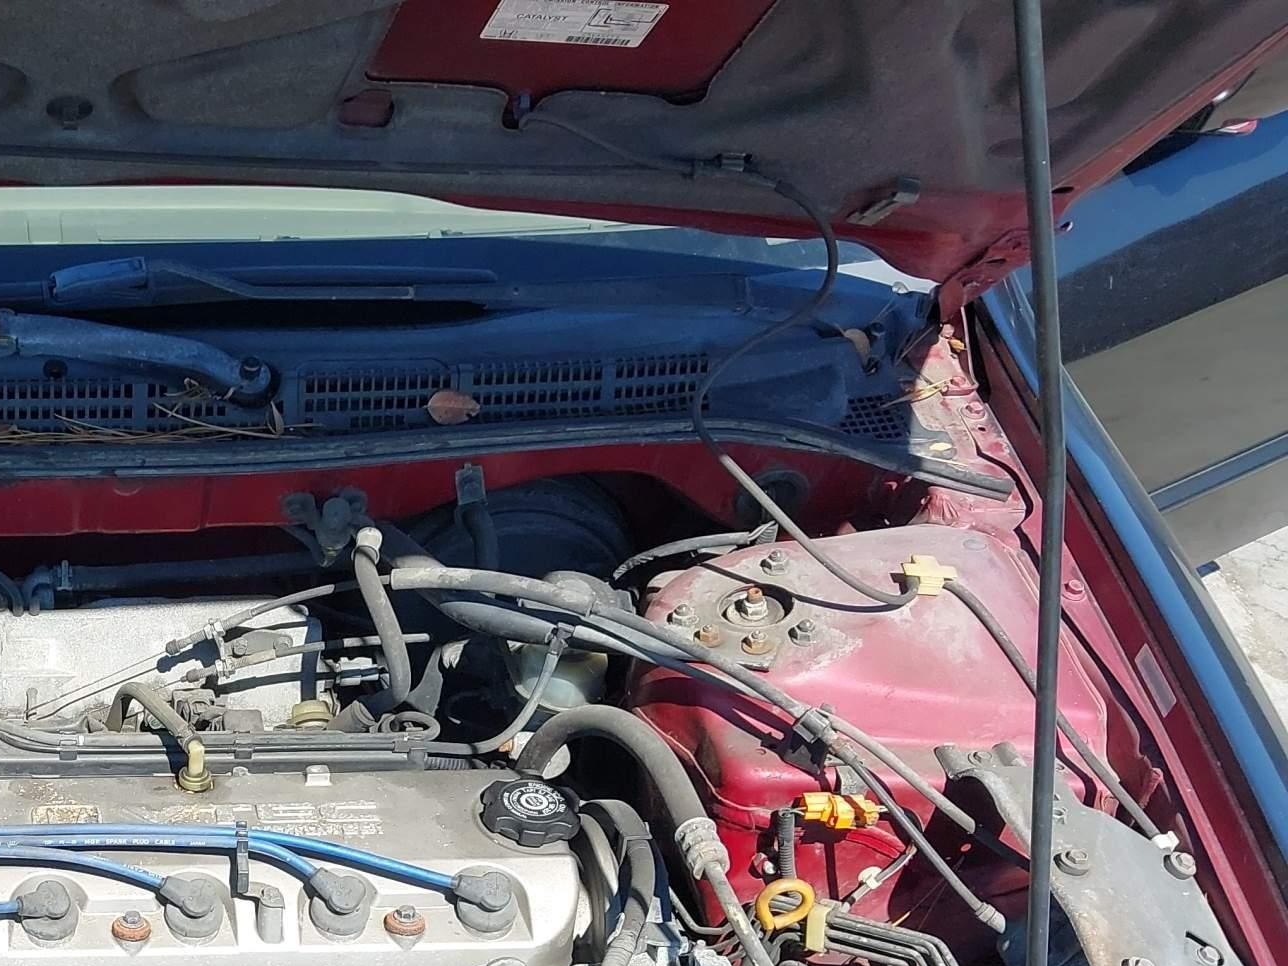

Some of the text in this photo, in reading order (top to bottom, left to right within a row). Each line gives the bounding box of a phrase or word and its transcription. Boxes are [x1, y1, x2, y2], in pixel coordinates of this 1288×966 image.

[515, 13, 568, 22] CATALYST
[105, 838, 128, 846] SPARK
[132, 838, 150, 846] PLUG
[154, 838, 176, 846] CABLE
